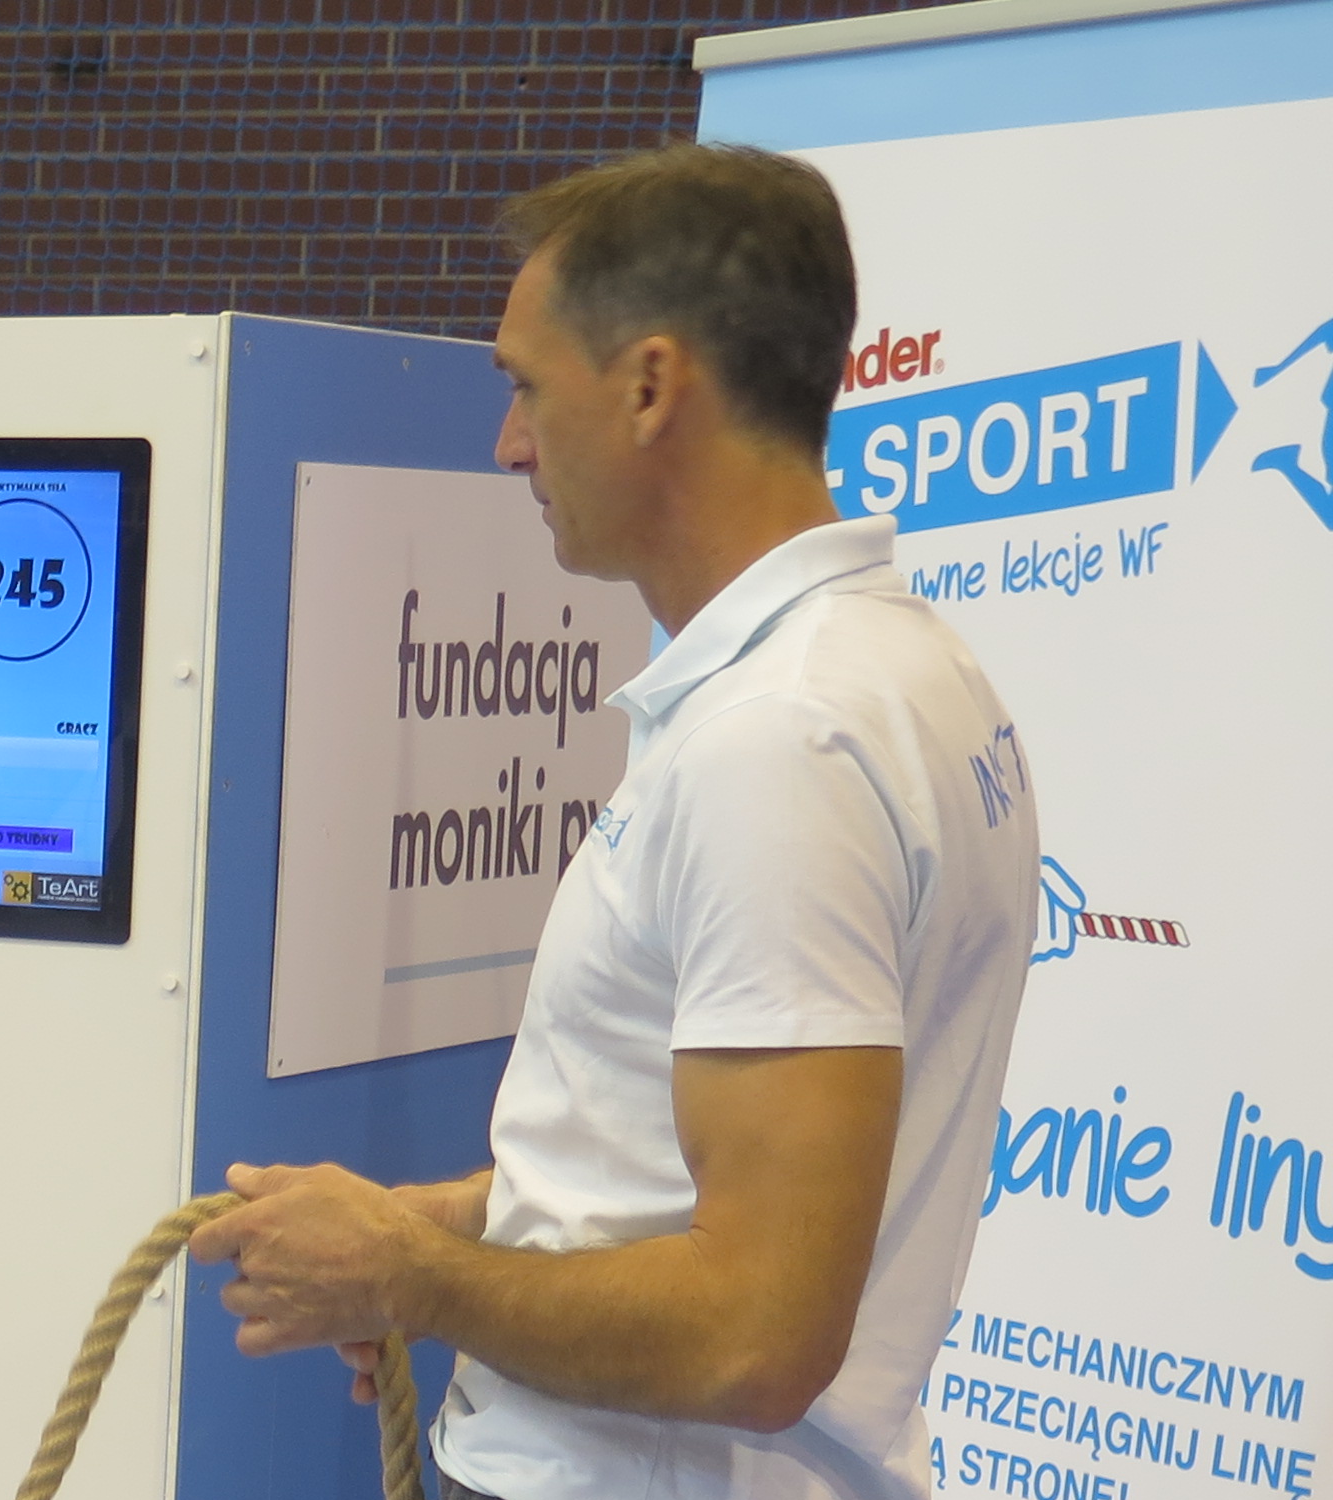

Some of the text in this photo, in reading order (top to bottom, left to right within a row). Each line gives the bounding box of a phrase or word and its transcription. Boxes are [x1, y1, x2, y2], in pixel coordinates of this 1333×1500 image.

[1002, 532, 1103, 597] lekcje
[1118, 522, 1169, 578] WF
[398, 588, 600, 749] fundacja
[56, 721, 99, 735] GRACZ
[6, 832, 59, 846] TRUDNY
[389, 757, 546, 891] moniki
[37, 877, 99, 897] TeArt
[971, 1312, 1305, 1423] MECHANICZNYM
[940, 1372, 1200, 1473] PRZECIĄGNIJ
